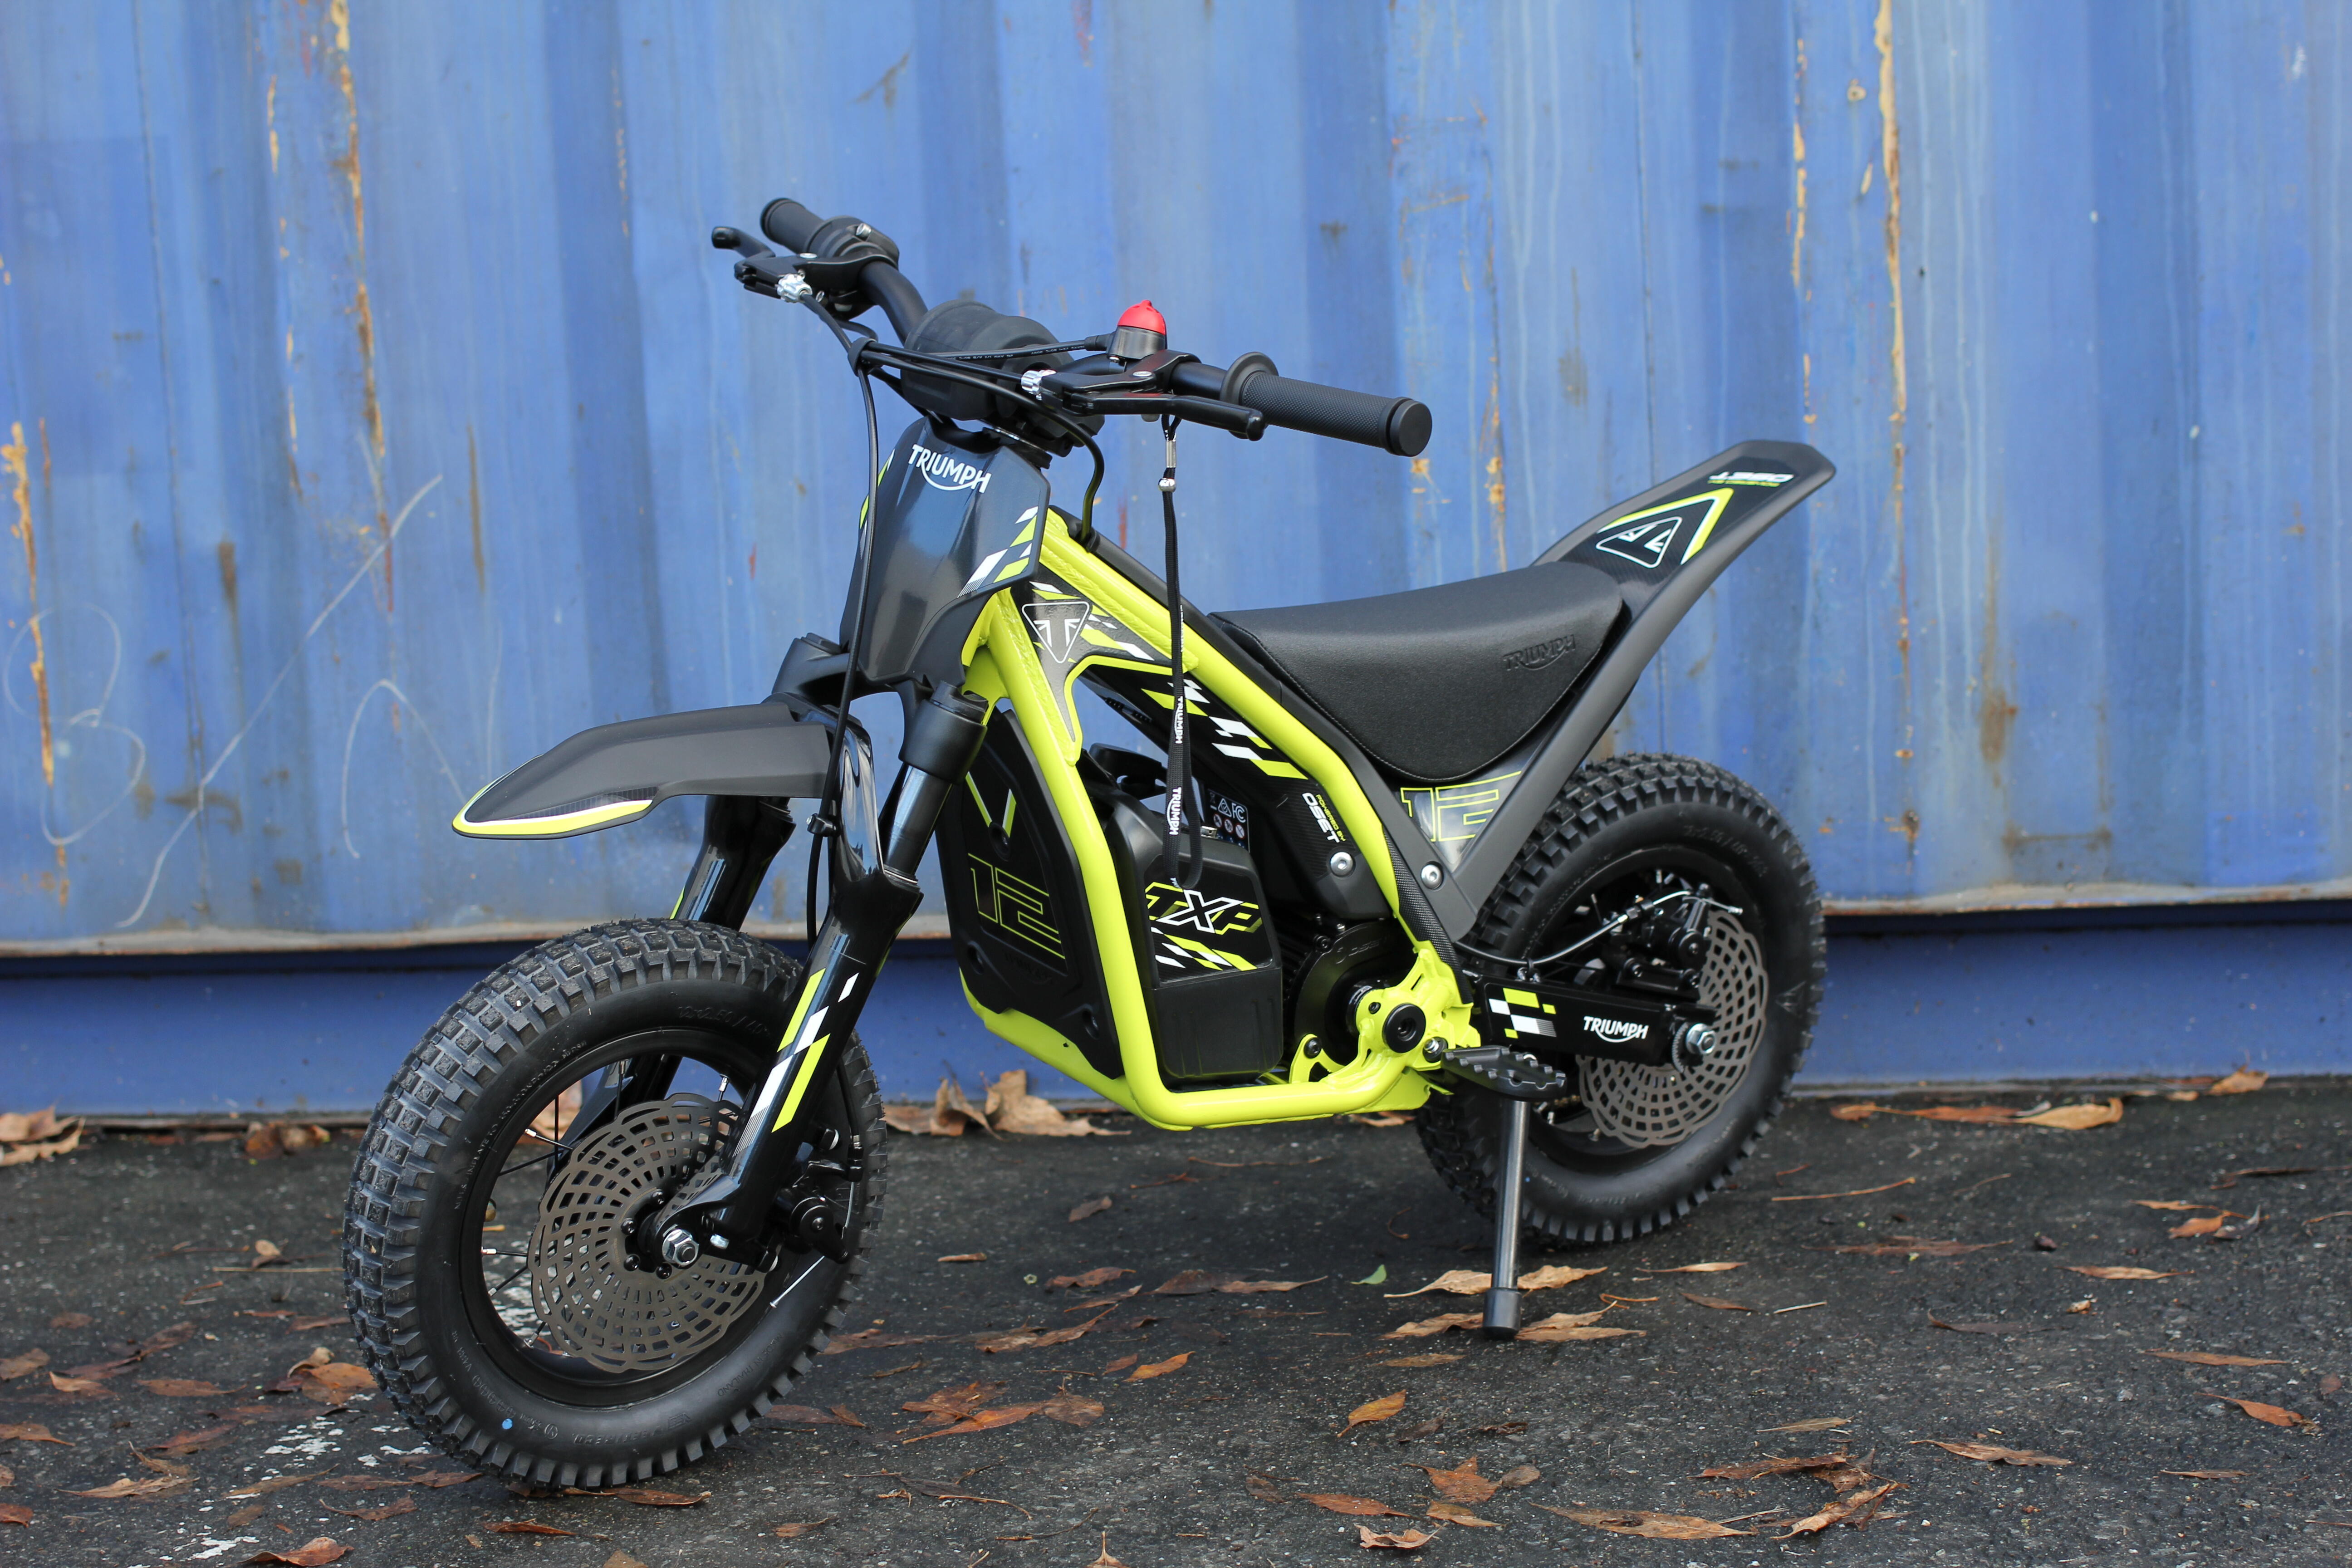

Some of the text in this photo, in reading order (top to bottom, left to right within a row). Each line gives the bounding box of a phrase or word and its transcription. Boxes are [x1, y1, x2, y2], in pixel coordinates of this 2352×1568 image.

[908, 444, 992, 494] TRIUMPH
[1502, 634, 1576, 671] TRIUMPH
[1174, 695, 1184, 745] TRIUMPH
[1166, 787, 1182, 836] TRIUMPH
[1302, 792, 1340, 843] OSET
[1315, 794, 1347, 842] POWERED BY
[968, 853, 1065, 960] 12
[1145, 882, 1263, 935] TXP
[1583, 1015, 1649, 1043] TRIUMPH
